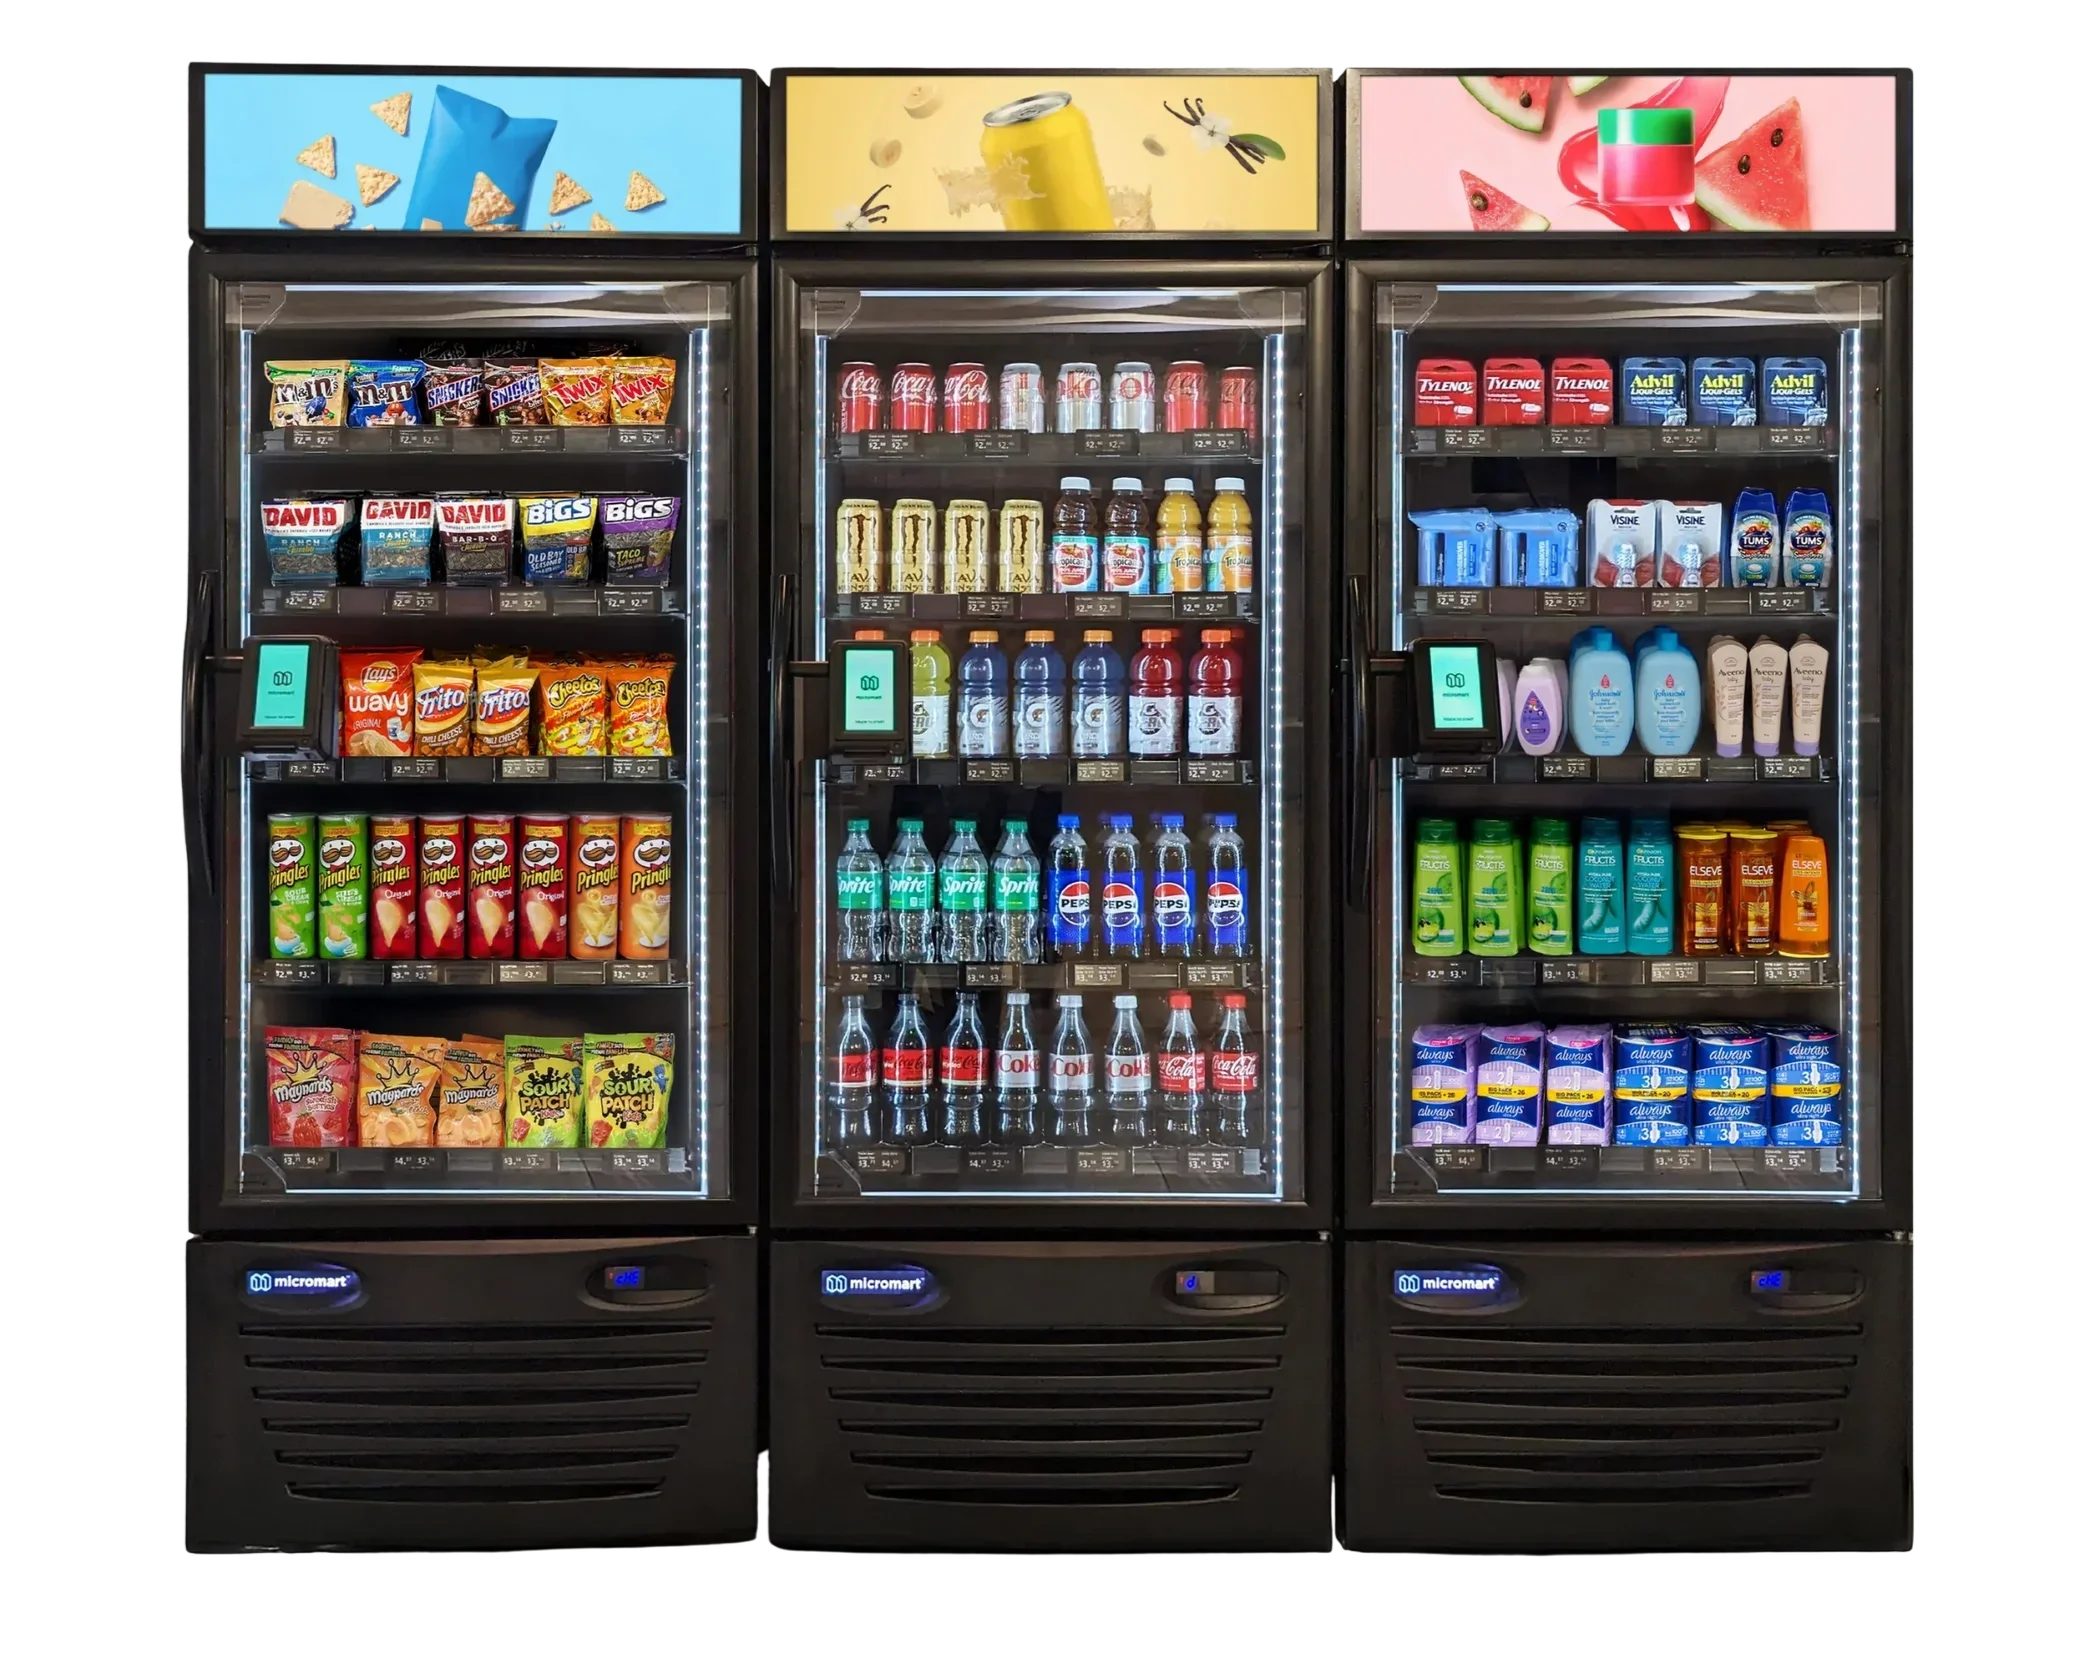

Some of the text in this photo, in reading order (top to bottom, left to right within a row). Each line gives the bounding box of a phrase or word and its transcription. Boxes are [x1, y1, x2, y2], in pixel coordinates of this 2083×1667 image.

[1486, 376, 1542, 391] TYLENOL
[1554, 376, 1610, 391] TYLENOL
[1630, 374, 1675, 388] Advil
[1700, 374, 1745, 388] Advil
[1771, 374, 1816, 388] Advil
[264, 507, 337, 527] DAVID
[366, 500, 431, 520] DAVID
[442, 503, 506, 524] DAVID
[1676, 515, 1706, 525] VISINE
[1742, 536, 1770, 545] TUMS
[1795, 536, 1823, 545] TUMS
[616, 550, 641, 561] TACO
[1718, 668, 1745, 676] Aveeno
[1753, 668, 1783, 676] Aveeno
[1793, 667, 1823, 675] Aveeno
[549, 674, 600, 708] Cheetos
[349, 691, 409, 715] wavy
[438, 724, 463, 742] CHEESE
[1585, 855, 1615, 864] FRUCTIS
[1633, 855, 1664, 864] FRUCTIS
[470, 863, 512, 889] Pringles
[520, 865, 564, 891] Pringles
[1490, 1044, 1527, 1060] always
[1556, 1048, 1593, 1064] always
[1630, 1047, 1673, 1063] always
[1709, 1047, 1752, 1063] always
[1789, 1042, 1829, 1059] always
[1425, 1077, 1431, 1089] 2
[1497, 1072, 1504, 1084] 2
[1564, 1077, 1571, 1089] 2
[1642, 1075, 1650, 1088] 3
[1720, 1075, 1729, 1088] 3
[1802, 1071, 1810, 1084] 3
[522, 1079, 570, 1096] SOUR
[604, 1079, 652, 1096] SOUR
[520, 1094, 570, 1112] PATCH
[602, 1095, 655, 1113] PATCH
[1488, 1101, 1524, 1117] always
[1418, 1104, 1455, 1119] always
[1556, 1106, 1593, 1121] always
[1630, 1103, 1672, 1120] always
[1708, 1103, 1751, 1120] always
[1426, 1130, 1433, 1141] 2
[1495, 1127, 1502, 1139] 2
[1565, 1131, 1572, 1143] 2
[1641, 1127, 1649, 1140] 3
[1720, 1128, 1728, 1140] 3
[1803, 1127, 1811, 1139] 3
[274, 1275, 346, 1288] micromart
[850, 1277, 922, 1290] micromart
[1423, 1277, 1495, 1290] micromart
